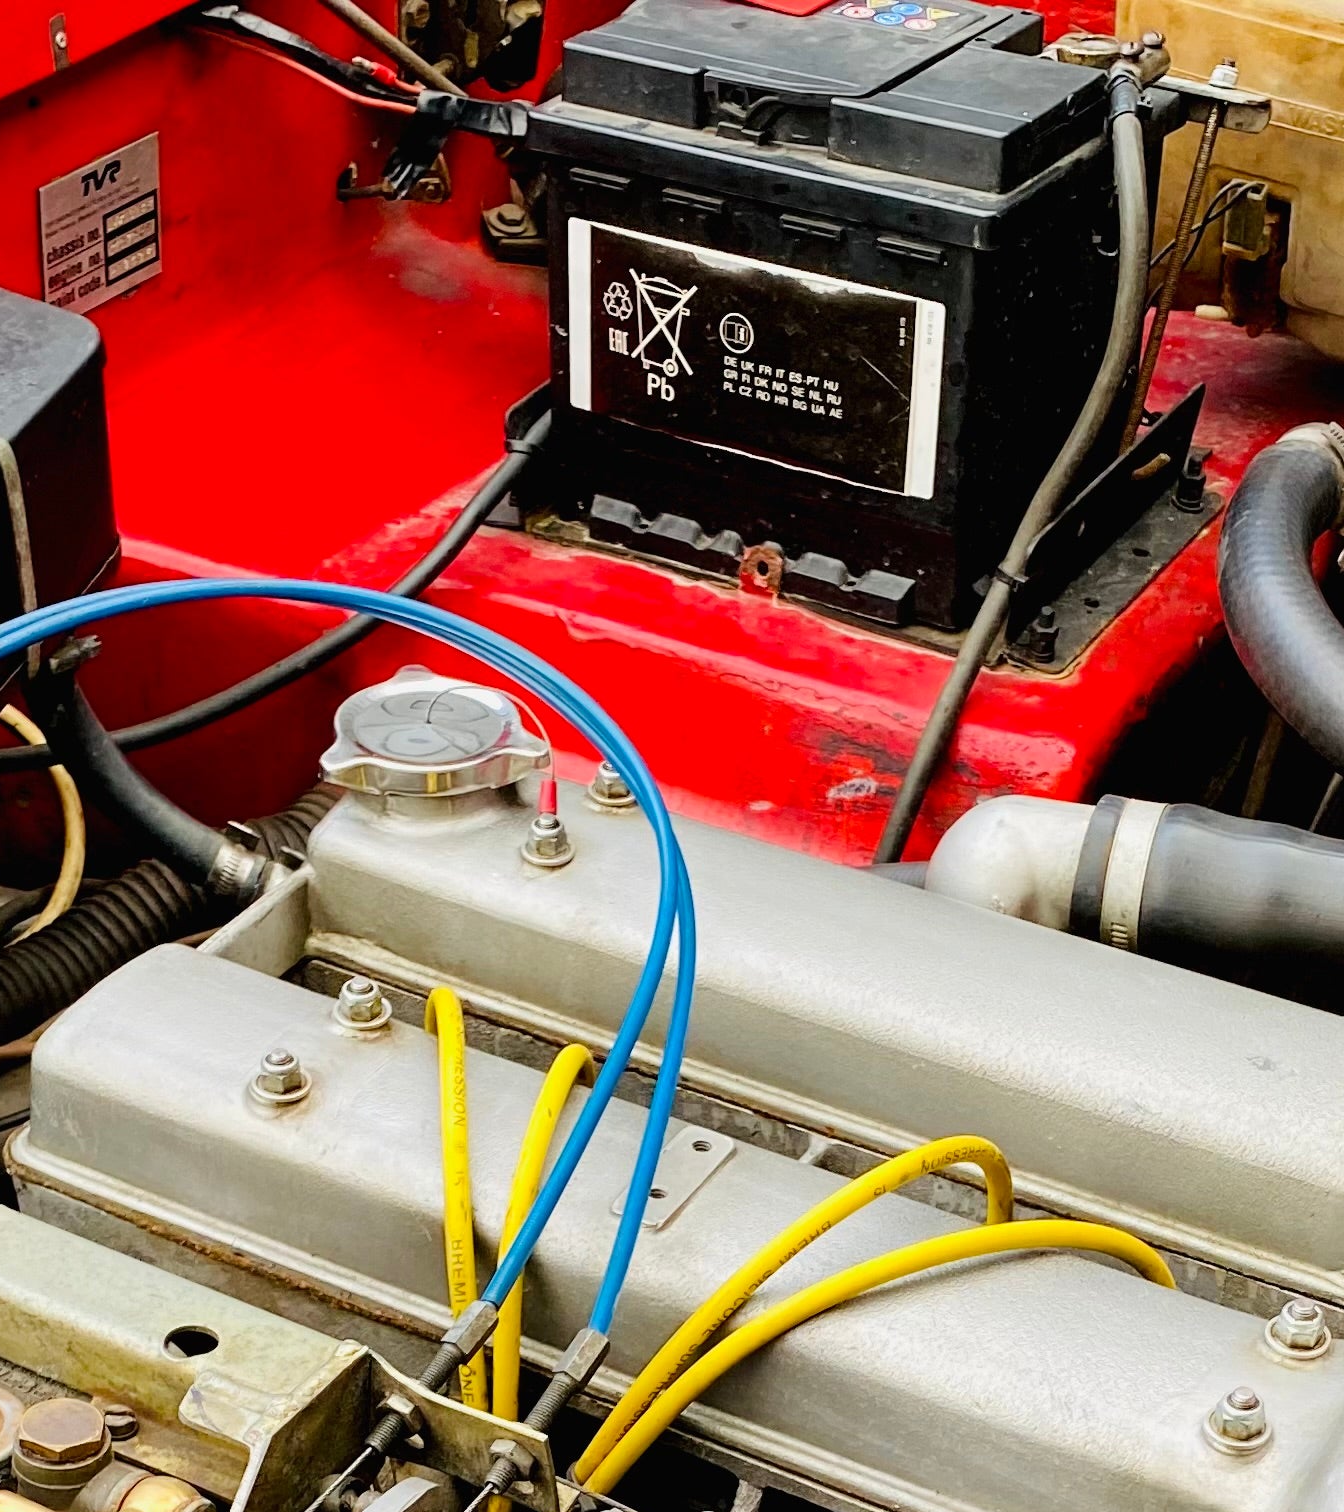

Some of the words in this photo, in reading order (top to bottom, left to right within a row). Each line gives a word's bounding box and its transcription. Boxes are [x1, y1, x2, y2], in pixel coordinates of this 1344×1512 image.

[81, 159, 122, 197] TVR
[647, 372, 675, 402] Pb
[723, 355, 738, 368] DE
[740, 360, 755, 373] UK
[758, 364, 773, 376] FR
[775, 368, 786, 379] IT
[823, 379, 840, 392] HU
[723, 368, 739, 381] GR
[741, 373, 751, 384] FI
[754, 376, 769, 389] DK
[771, 381, 788, 393] NO
[791, 385, 806, 398] SE
[808, 389, 823, 402] NL
[826, 393, 843, 406] RU
[723, 381, 736, 393] PL
[738, 385, 753, 398] CZ
[755, 389, 771, 402] RO
[774, 394, 789, 407] HR
[792, 399, 808, 411] BG
[810, 403, 826, 415] UA
[828, 408, 843, 419] AE
[778, 1219, 833, 1267] BREMI
[452, 1238, 467, 1310] BREMI
[702, 1268, 776, 1340] SILICONE
